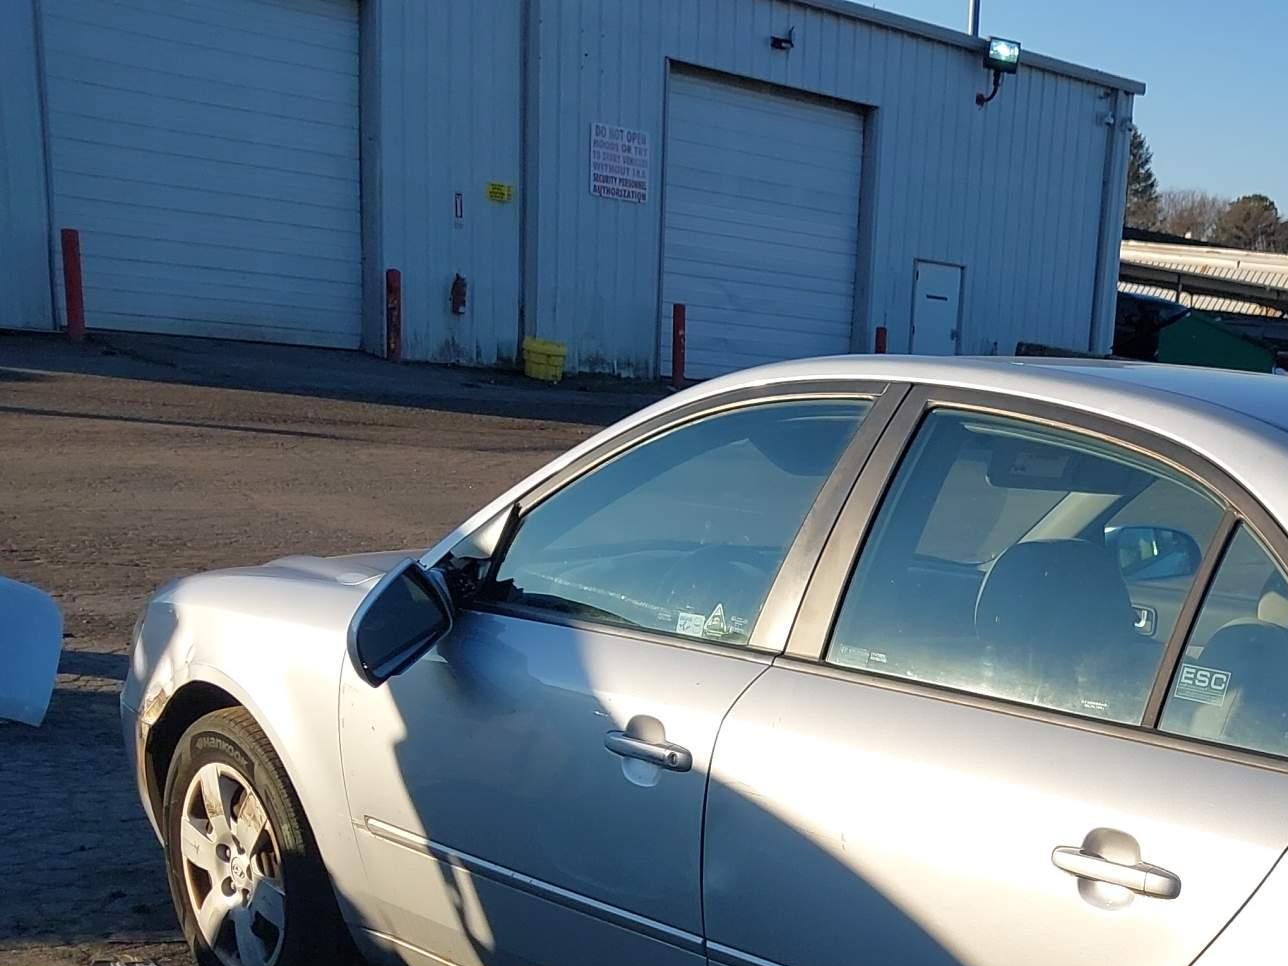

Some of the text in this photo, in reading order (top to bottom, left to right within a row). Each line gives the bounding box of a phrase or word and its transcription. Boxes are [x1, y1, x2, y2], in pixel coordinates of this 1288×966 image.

[595, 124, 607, 138] DO
[626, 130, 647, 145] OPEN
[593, 161, 630, 176] WITHOUT
[593, 172, 617, 185] SECURITY
[593, 184, 647, 201] AUTHORIZATION
[1180, 667, 1227, 690] ESC
